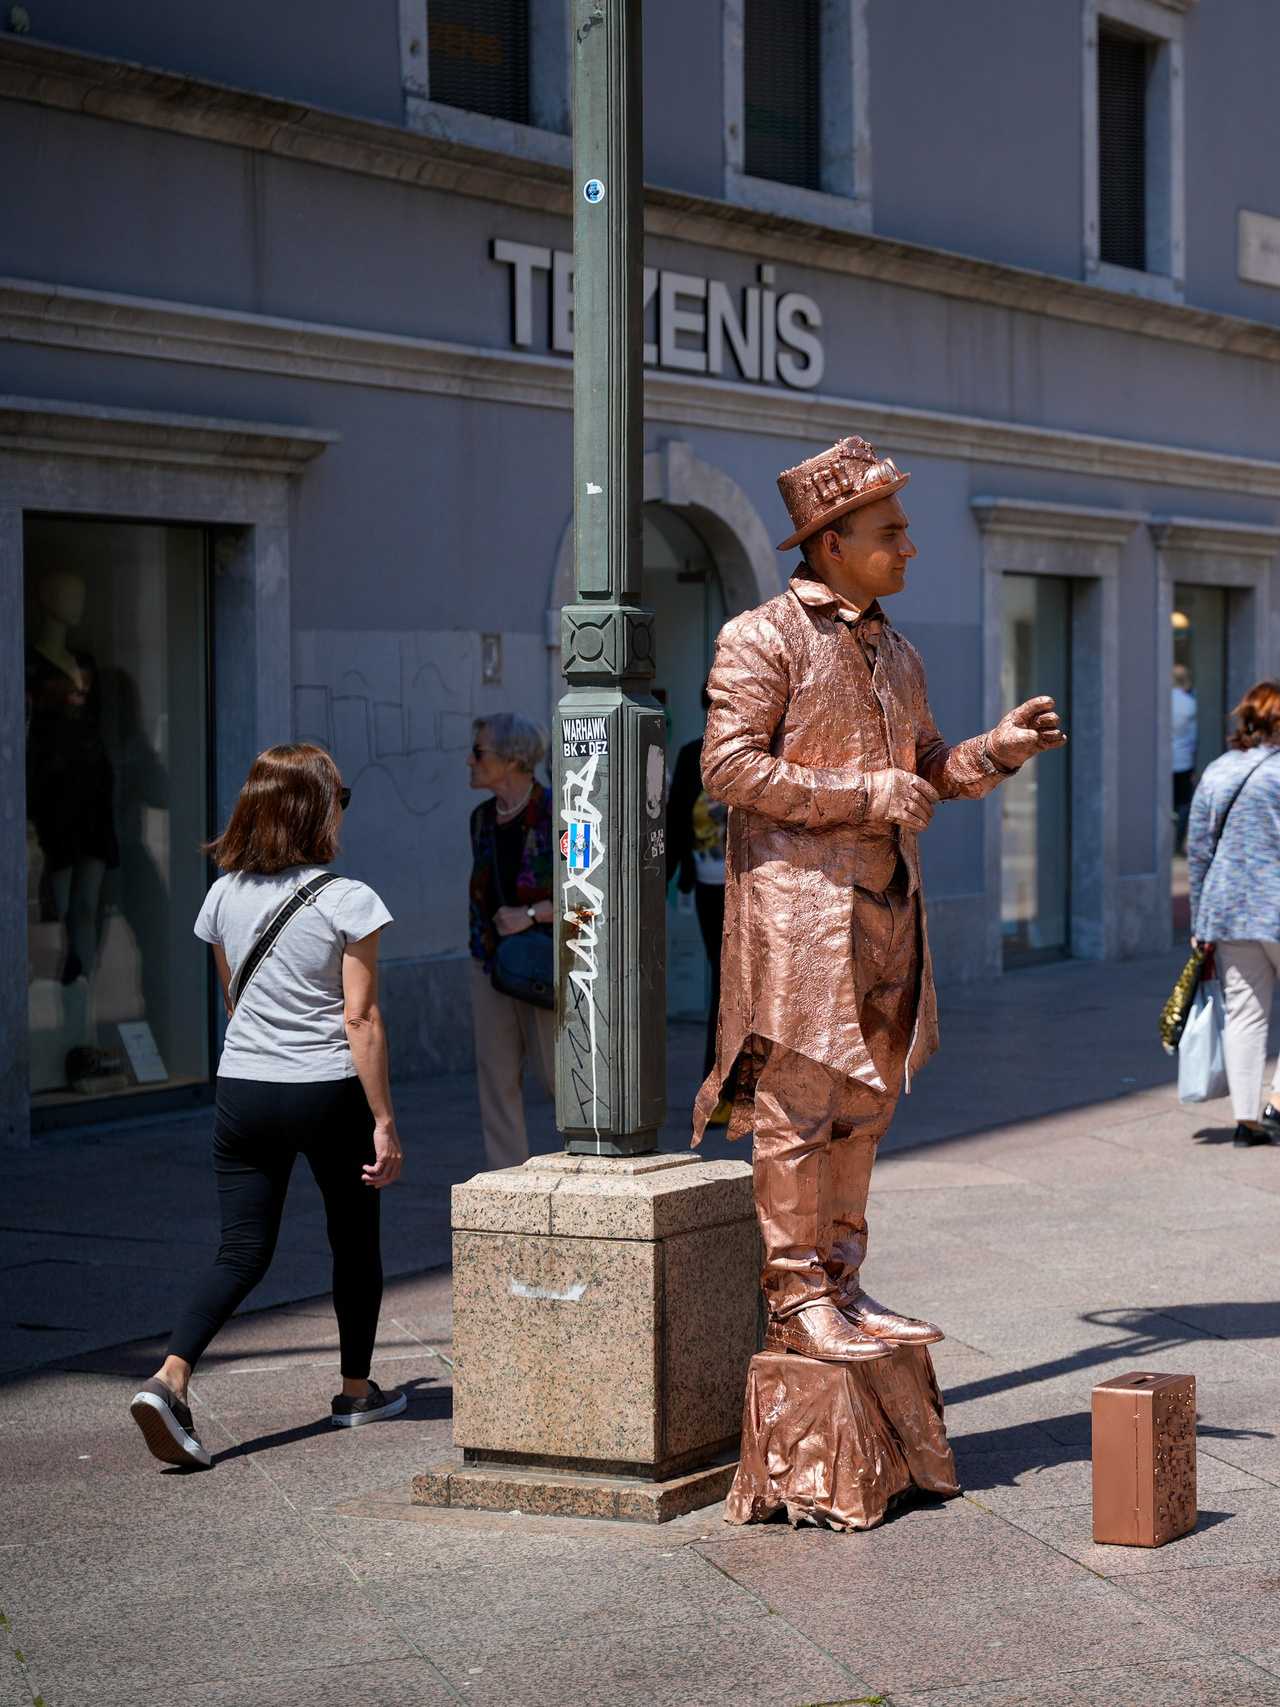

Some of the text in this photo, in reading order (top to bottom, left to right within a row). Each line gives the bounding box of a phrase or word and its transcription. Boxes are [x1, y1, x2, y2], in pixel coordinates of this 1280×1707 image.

[563, 718, 608, 741] WARHAWK
[564, 743, 579, 757] BK
[588, 741, 609, 756] DEZ
